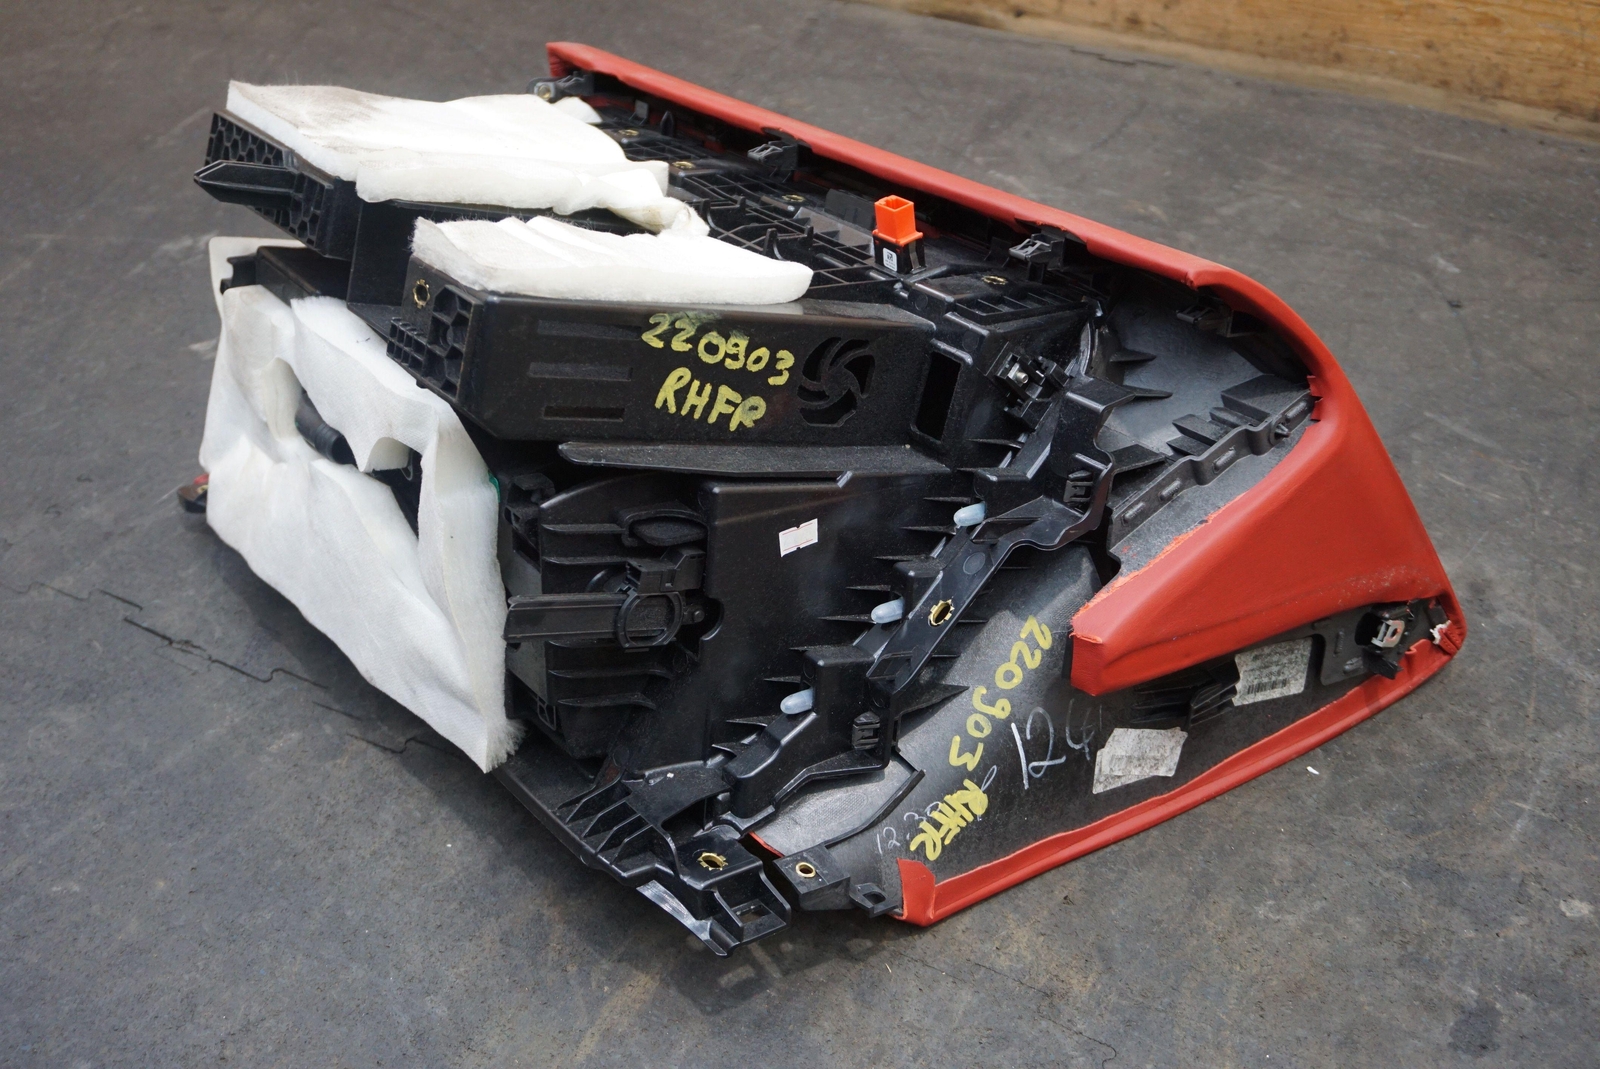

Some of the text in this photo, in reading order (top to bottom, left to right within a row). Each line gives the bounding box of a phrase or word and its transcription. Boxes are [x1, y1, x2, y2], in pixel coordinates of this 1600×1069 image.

[641, 312, 795, 386] 220903
[654, 366, 767, 432] RHFR
[949, 615, 1052, 771] 220903
